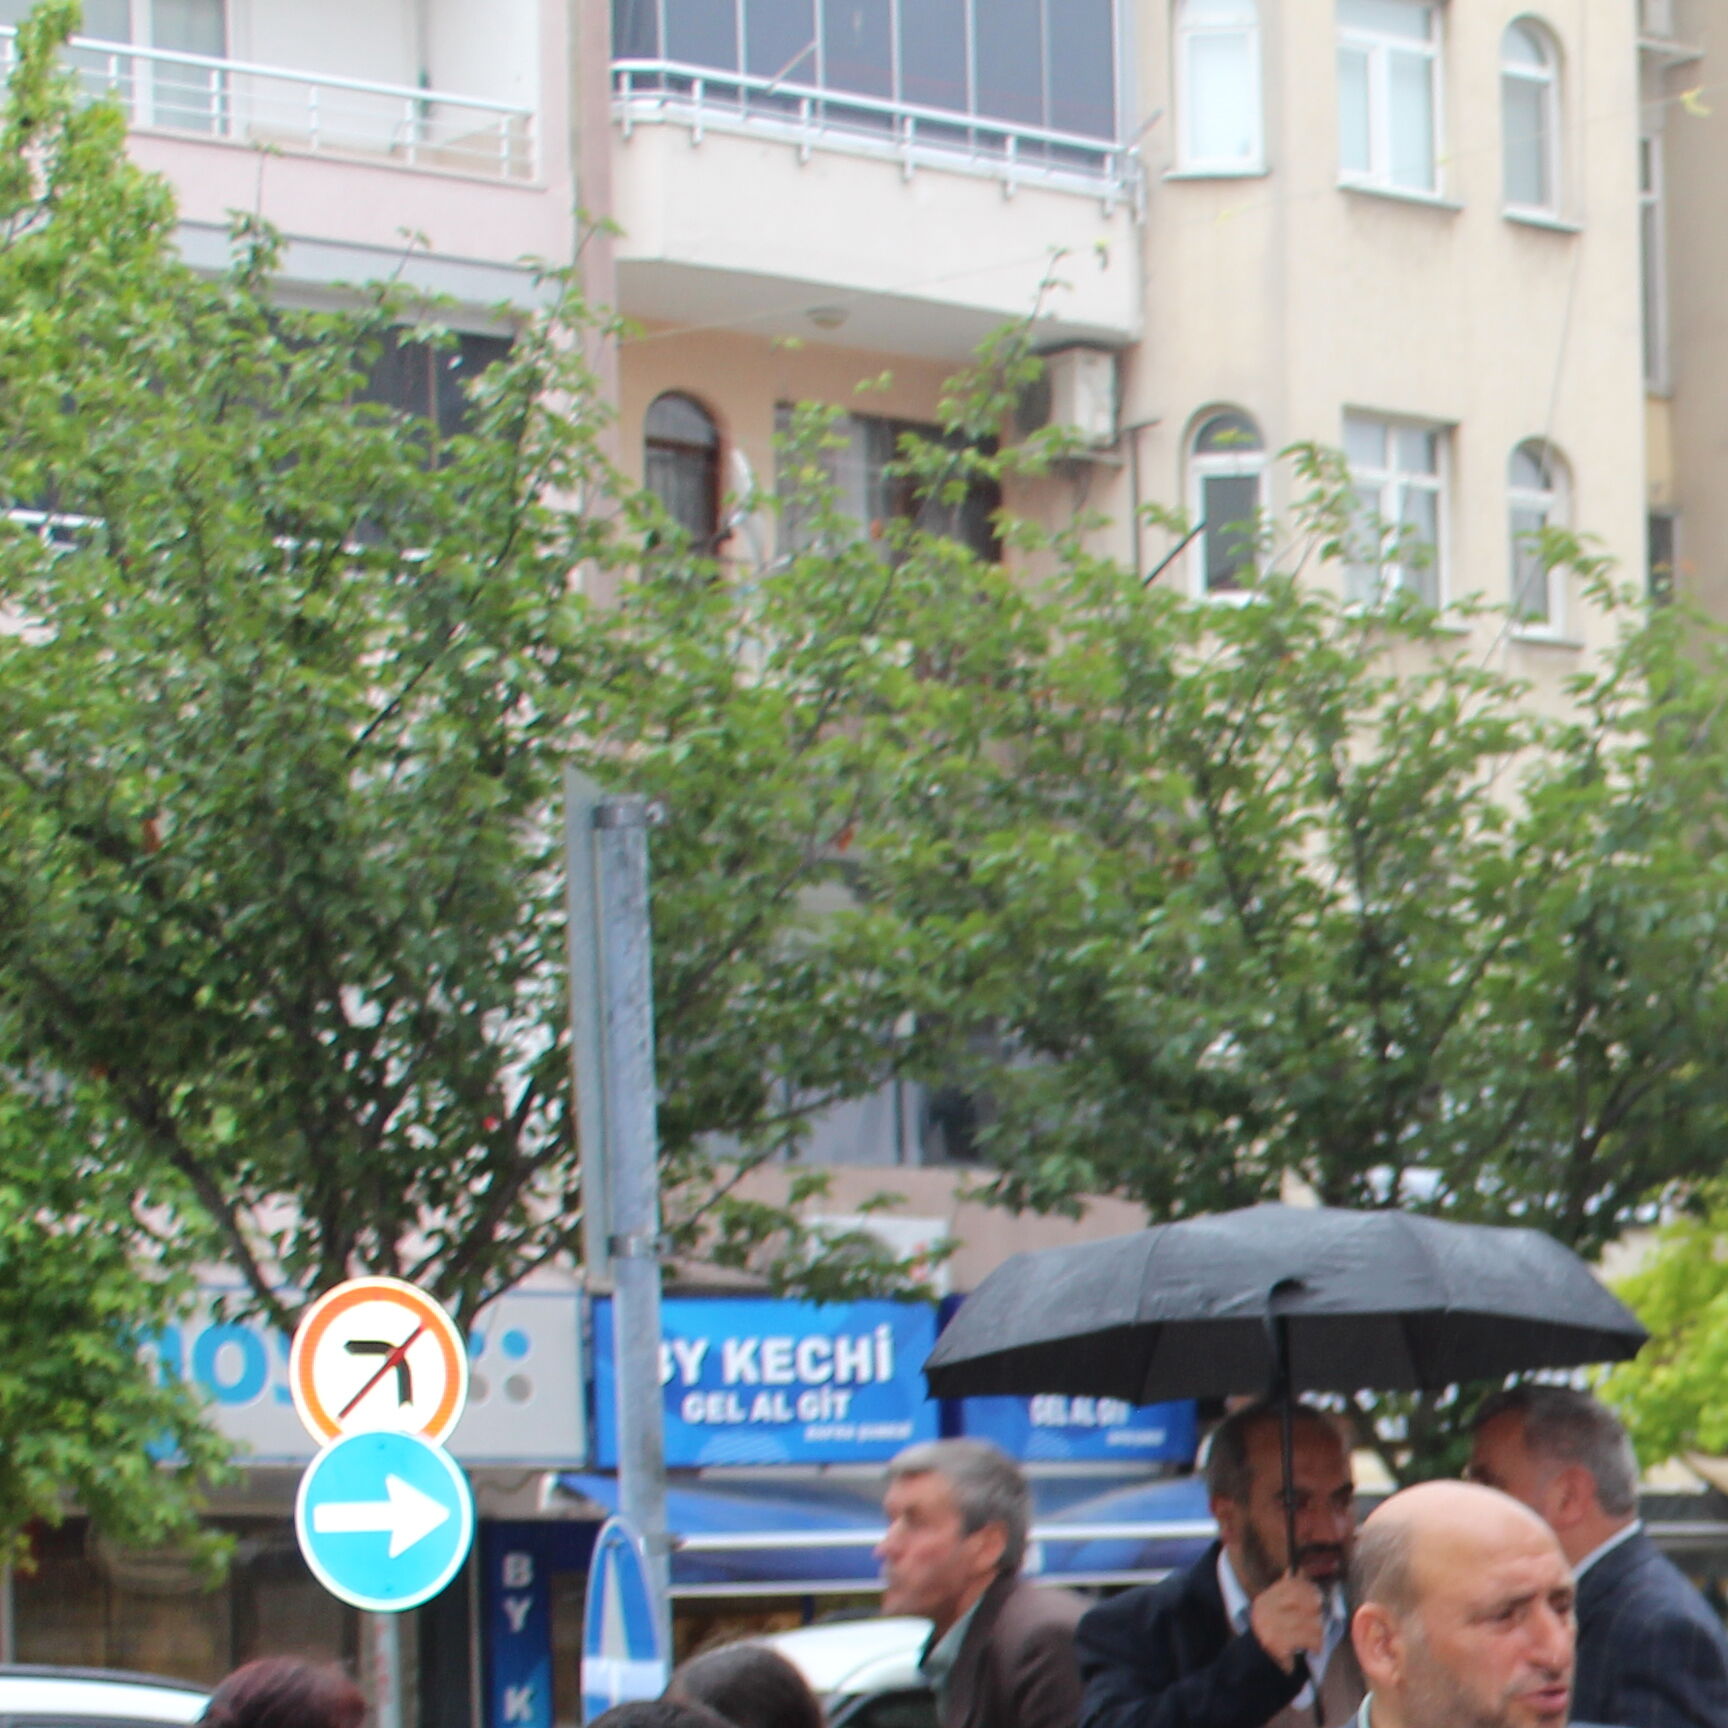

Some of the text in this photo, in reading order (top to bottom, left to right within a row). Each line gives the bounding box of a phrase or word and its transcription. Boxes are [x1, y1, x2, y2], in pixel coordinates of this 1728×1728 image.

[722, 1323, 894, 1386] KECHİ
[682, 1384, 853, 1424] GEL AL GİT
